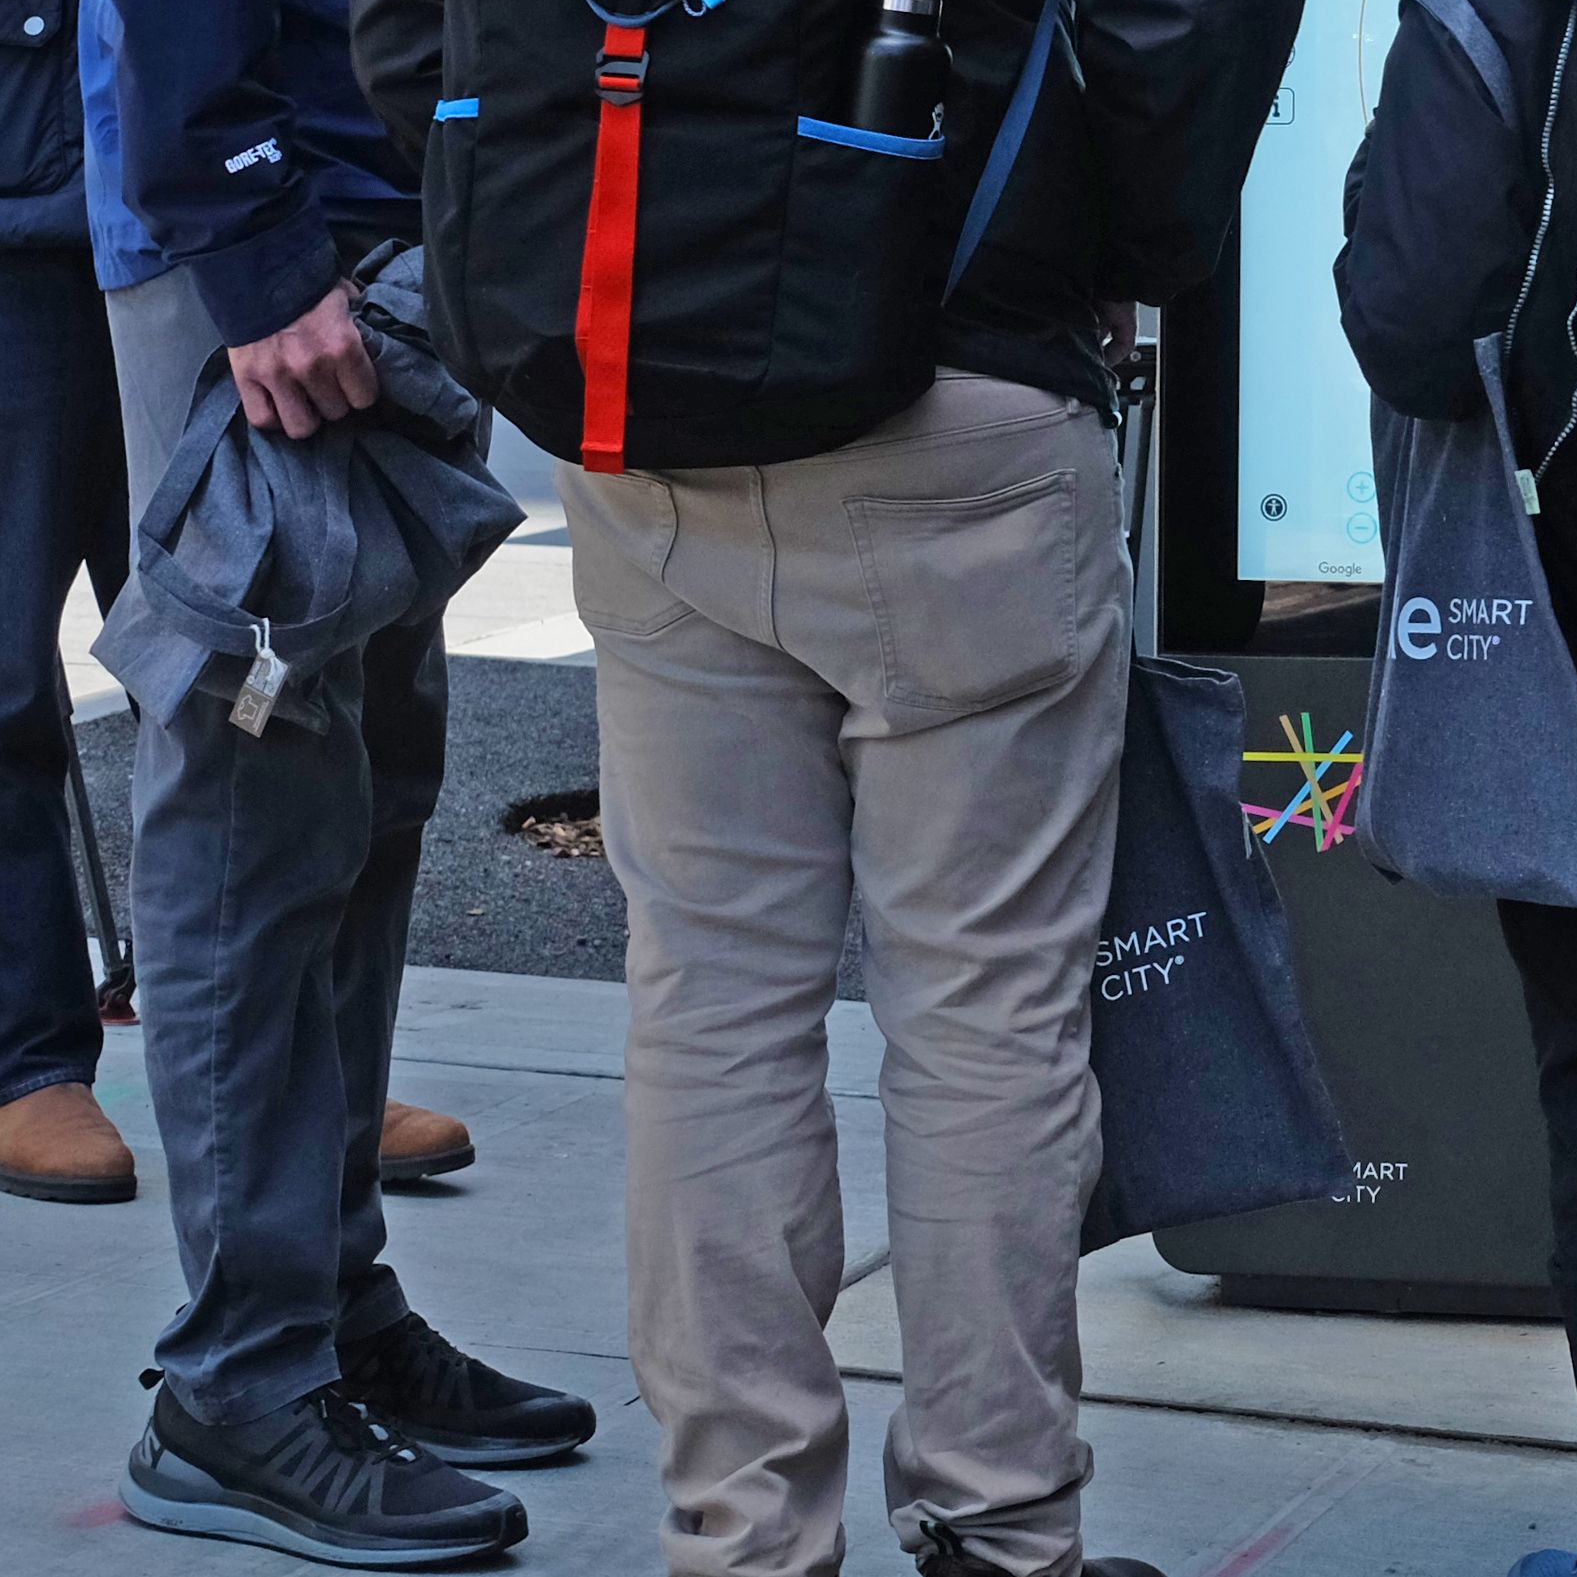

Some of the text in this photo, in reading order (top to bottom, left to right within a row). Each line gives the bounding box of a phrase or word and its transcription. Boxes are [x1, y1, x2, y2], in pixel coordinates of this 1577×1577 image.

[224, 137, 278, 174] GORE-TEX
[1318, 561, 1362, 577] Google
[1447, 598, 1534, 626] SMART
[1095, 911, 1207, 966] SMART
[1331, 1185, 1382, 1204] TY
